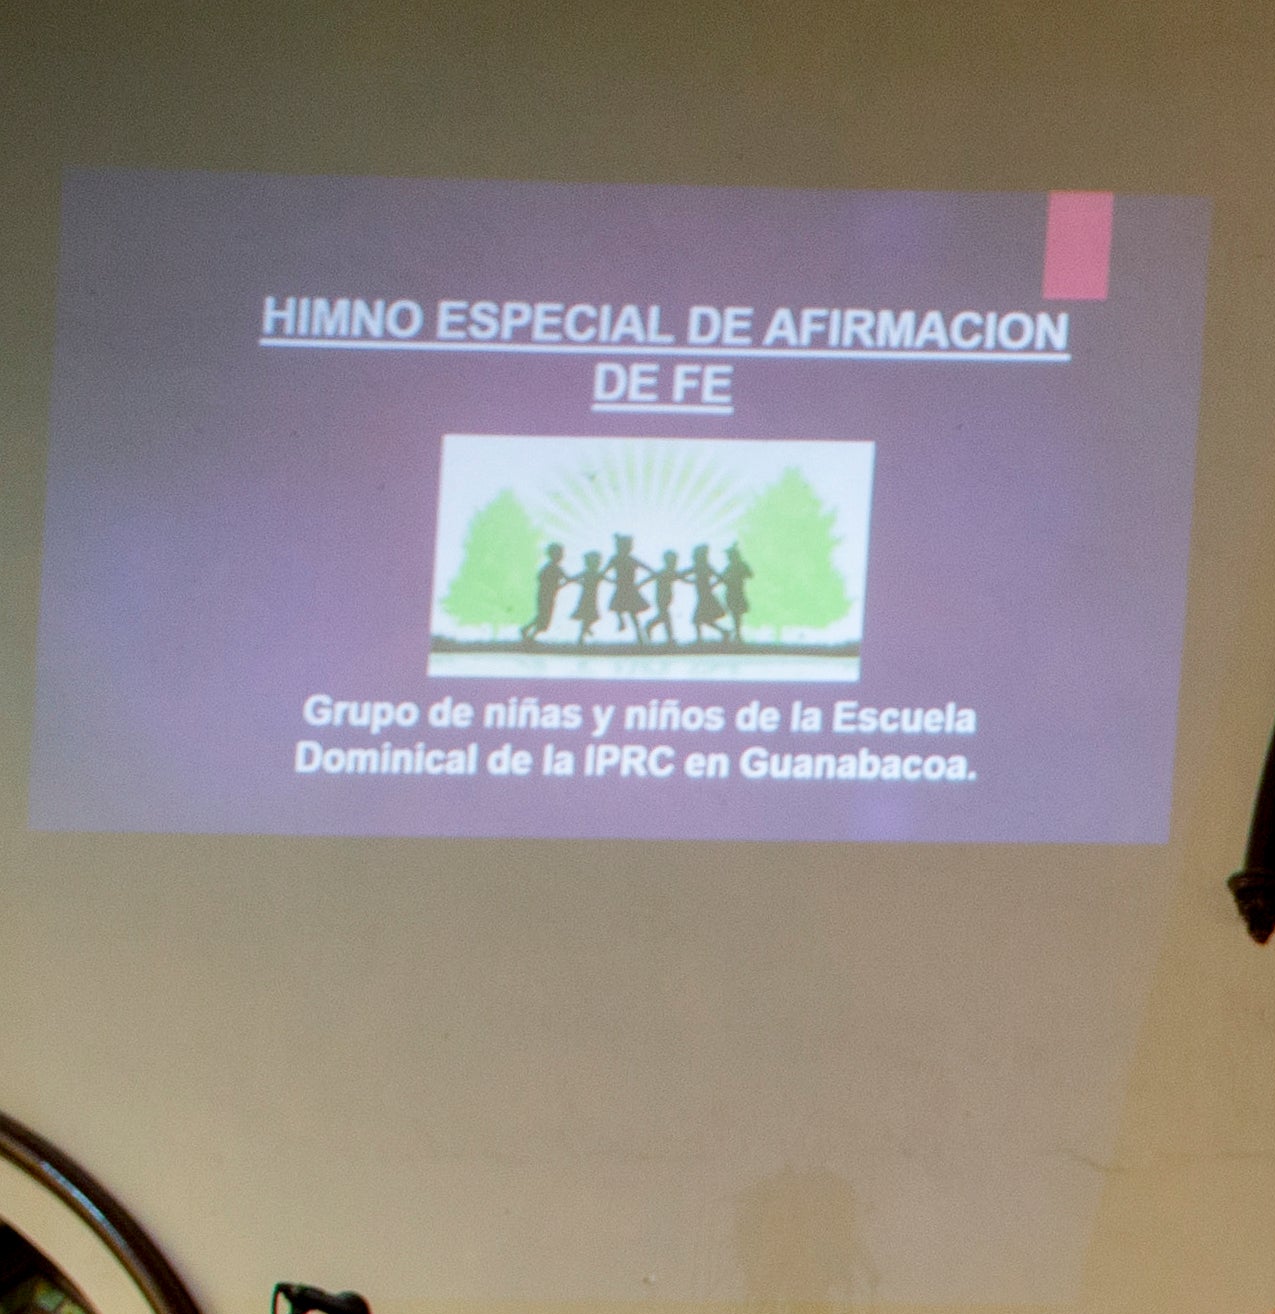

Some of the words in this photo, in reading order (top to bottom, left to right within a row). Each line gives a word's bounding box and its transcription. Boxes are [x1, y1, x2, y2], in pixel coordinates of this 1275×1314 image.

[261, 295, 425, 340] HIMNO
[435, 299, 676, 345] ESPECIAL
[685, 305, 756, 347] DE
[761, 306, 1071, 352] AFIRMACION
[593, 361, 661, 403] DE
[671, 363, 735, 405] FE
[302, 693, 421, 735] Grupo
[426, 696, 475, 729] de
[483, 696, 584, 731] niñas
[590, 702, 616, 738] y
[623, 698, 726, 732] niños
[734, 700, 782, 733] de
[789, 700, 823, 734] la
[831, 700, 978, 735] Escuela
[294, 739, 479, 776] Dominical
[485, 742, 534, 777] de
[541, 743, 575, 777] la
[583, 743, 676, 779] IPRC
[683, 751, 731, 780] en
[738, 746, 978, 783] Guanabacoa.
